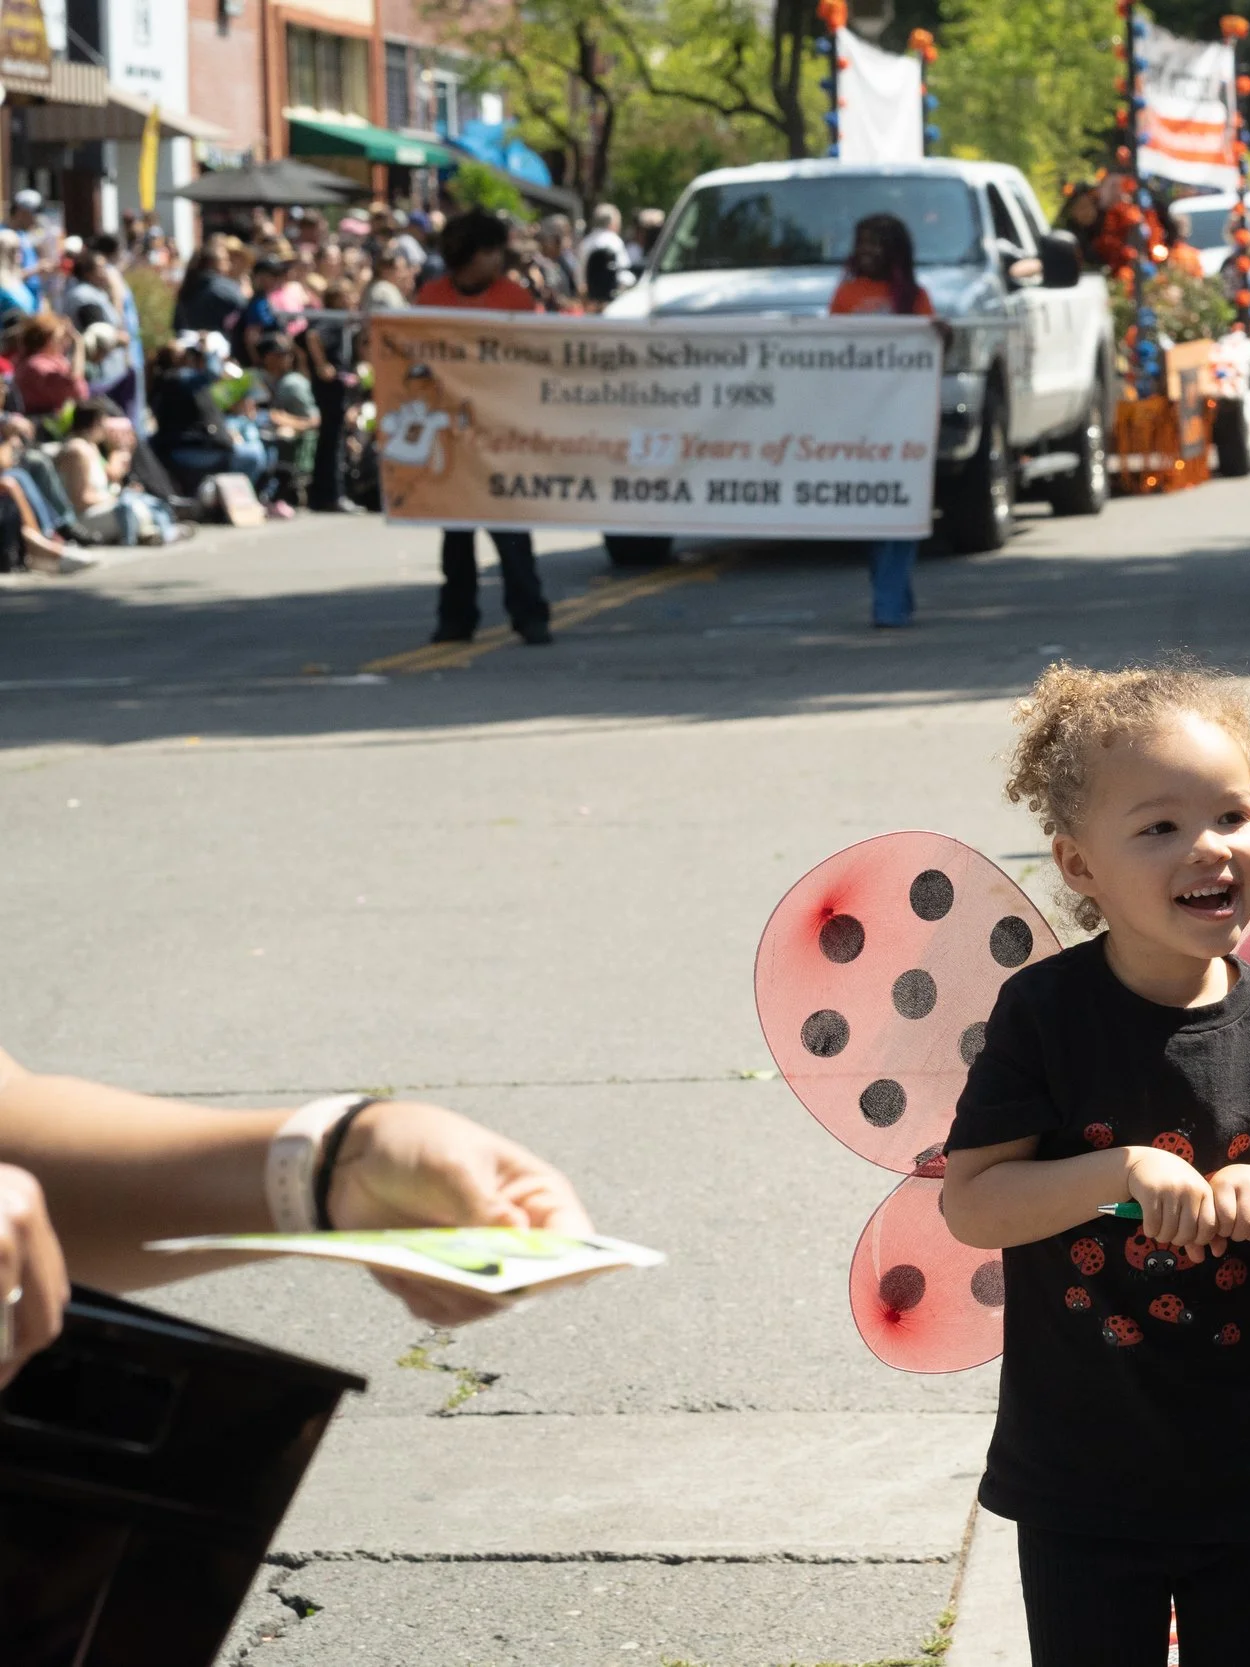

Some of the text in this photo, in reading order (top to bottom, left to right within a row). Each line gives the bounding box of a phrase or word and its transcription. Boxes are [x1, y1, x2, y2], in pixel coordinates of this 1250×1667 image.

[562, 339, 638, 372] High
[646, 339, 747, 370] School
[757, 341, 933, 371] Foundation
[541, 378, 775, 408] Established 1988
[637, 431, 674, 458] 37
[681, 433, 751, 461] Years
[760, 432, 794, 467] of
[795, 434, 893, 462] Service
[902, 439, 928, 461] to
[489, 473, 911, 507] SANTA ROSA HIGH SCHOOL
